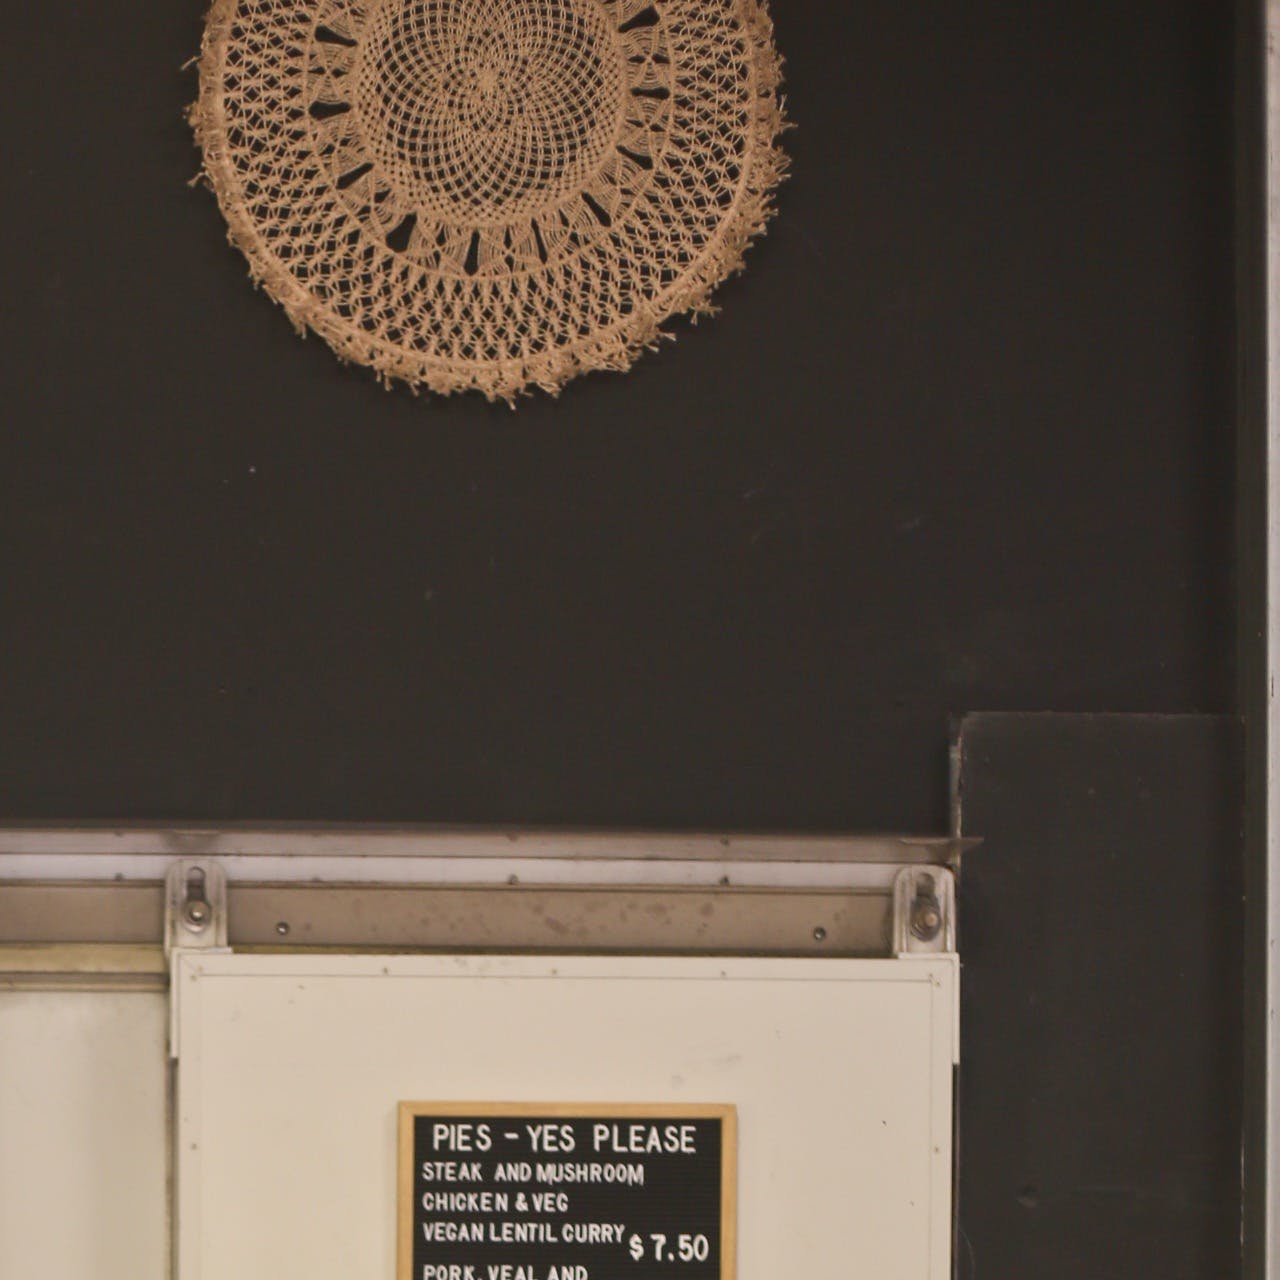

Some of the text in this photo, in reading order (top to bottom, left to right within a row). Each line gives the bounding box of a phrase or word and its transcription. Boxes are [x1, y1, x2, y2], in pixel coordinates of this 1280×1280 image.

[432, 1123, 492, 1152] PIES
[525, 1124, 576, 1153] YES
[593, 1123, 697, 1154] PLEASE
[422, 1161, 645, 1186] STEAK AND MUSHROOM
[422, 1191, 569, 1213] CHICKEN & VEG
[422, 1221, 626, 1244] VEGAN LENTIL CURRY
